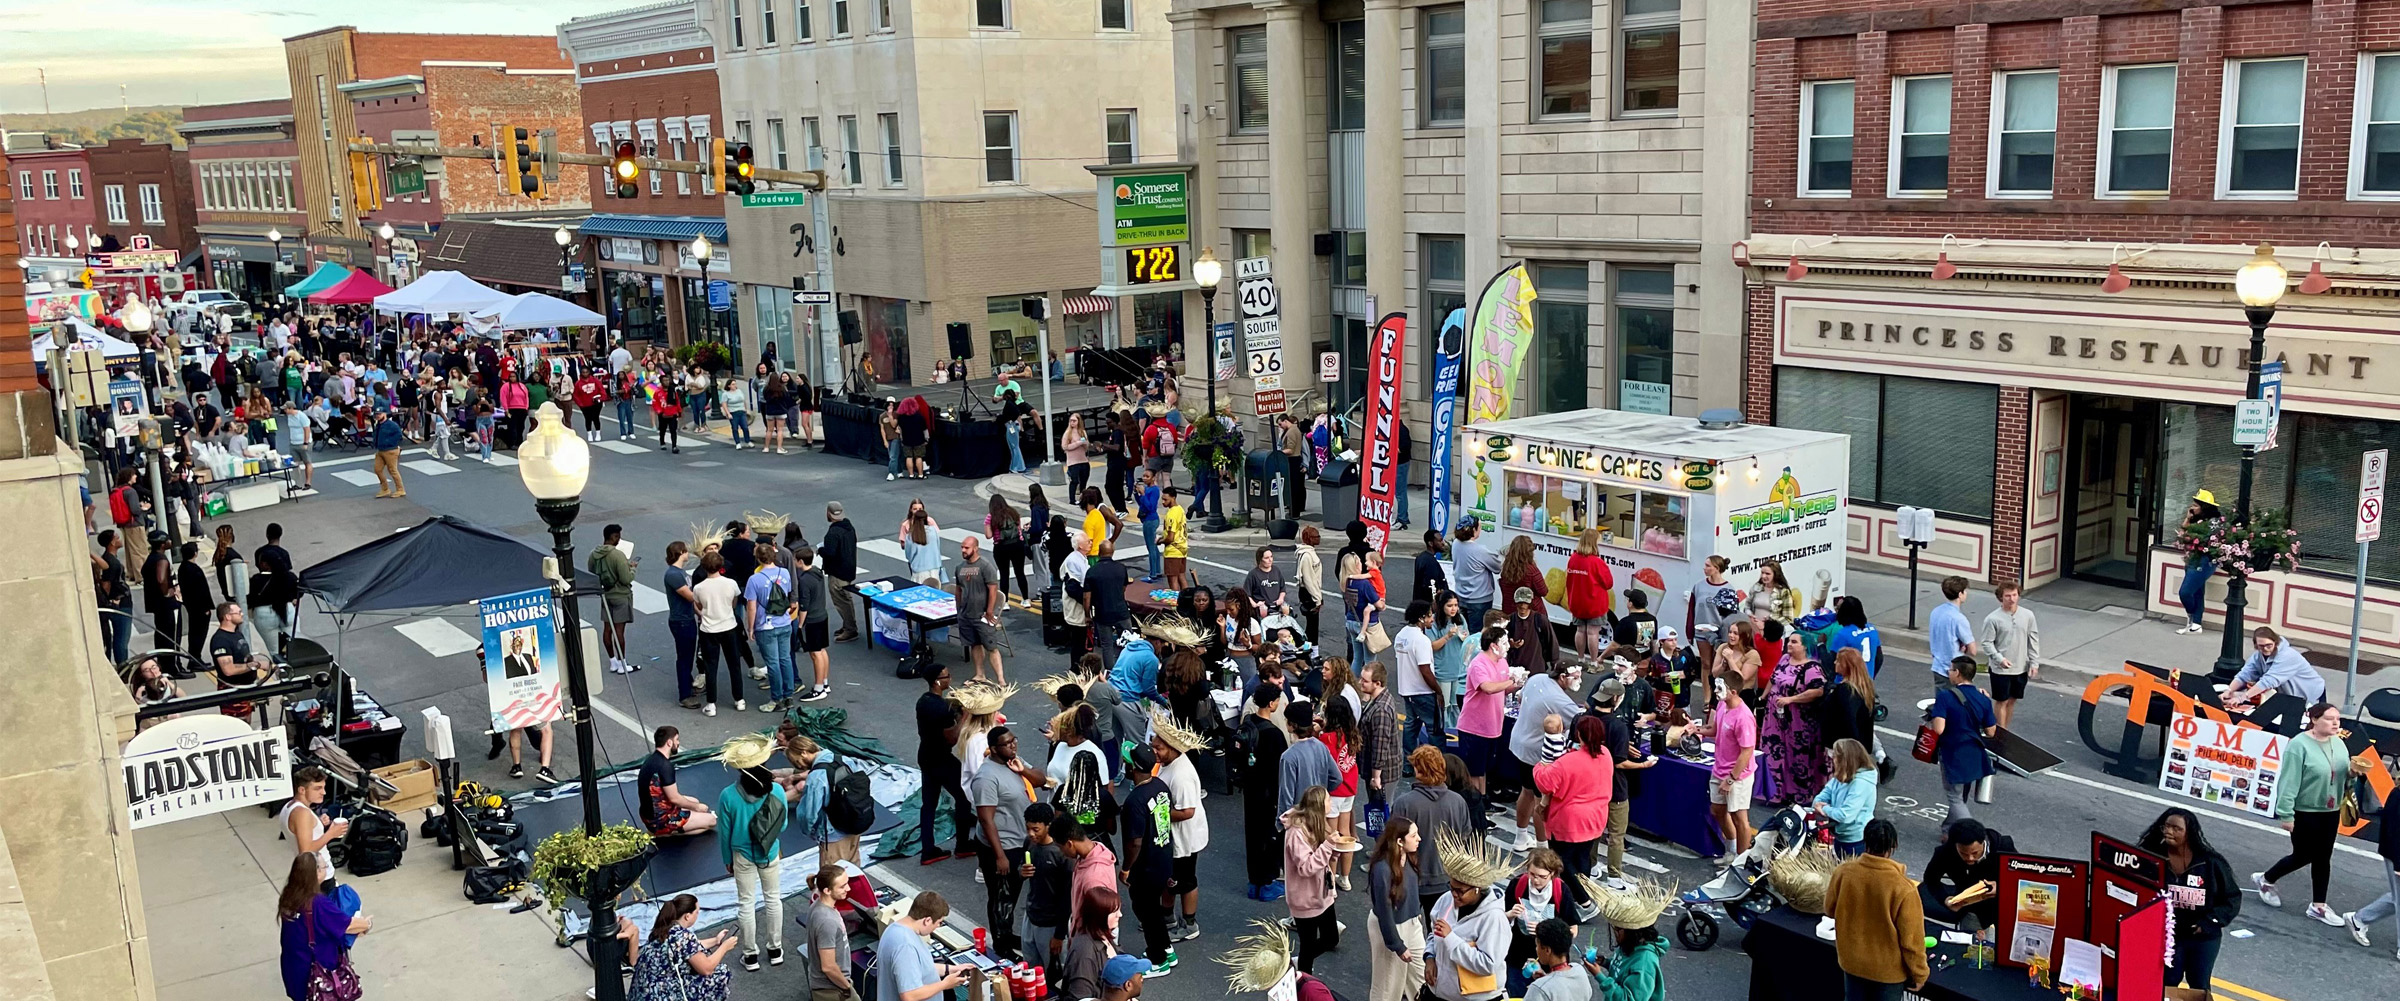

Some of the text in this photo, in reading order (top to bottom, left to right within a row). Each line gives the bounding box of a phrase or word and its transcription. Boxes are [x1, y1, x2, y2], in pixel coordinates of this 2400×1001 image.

[1134, 182, 1179, 194] Somerset
[750, 195, 795, 204] Broadway
[1136, 193, 1162, 205] Trust
[1117, 219, 1133, 228] ATM
[1117, 230, 1157, 240] DRIVE-THRU
[1166, 228, 1185, 236] BACK
[136, 238, 147, 250] P
[1243, 261, 1264, 274] ALT
[1243, 286, 1272, 308] 40
[1247, 321, 1278, 334] SOUTH
[1249, 339, 1280, 348] MARYLAND
[1818, 320, 2370, 379] PRINCESS RESTAURANT
[1252, 352, 1281, 374] 36
[1624, 382, 1667, 393] FOR LEASE
[1257, 392, 1283, 402] Mountain
[1258, 402, 1285, 413] Maryland
[1370, 328, 1396, 493] FUNNEL
[1489, 438, 1501, 446] HOT
[1527, 444, 1663, 481] FUNNEL CAKES
[1684, 464, 1700, 473] HOT
[1688, 479, 1710, 487] FRESH
[1729, 495, 1837, 535] Turtle's Treats
[1738, 518, 1827, 546] WATER ICE DONUTS COFFEE
[486, 594, 545, 612] FROSTBURG
[484, 603, 549, 628] HONORS
[1861, 637, 1870, 662] 1
[177, 732, 200, 749] The
[2198, 748, 2254, 768] PHI MU DELTA
[123, 738, 284, 806] LADSTONE
[134, 785, 260, 821] MERCANTILE
[2011, 860, 2072, 874] Upcoming Events
[2114, 851, 2140, 869] UPC
